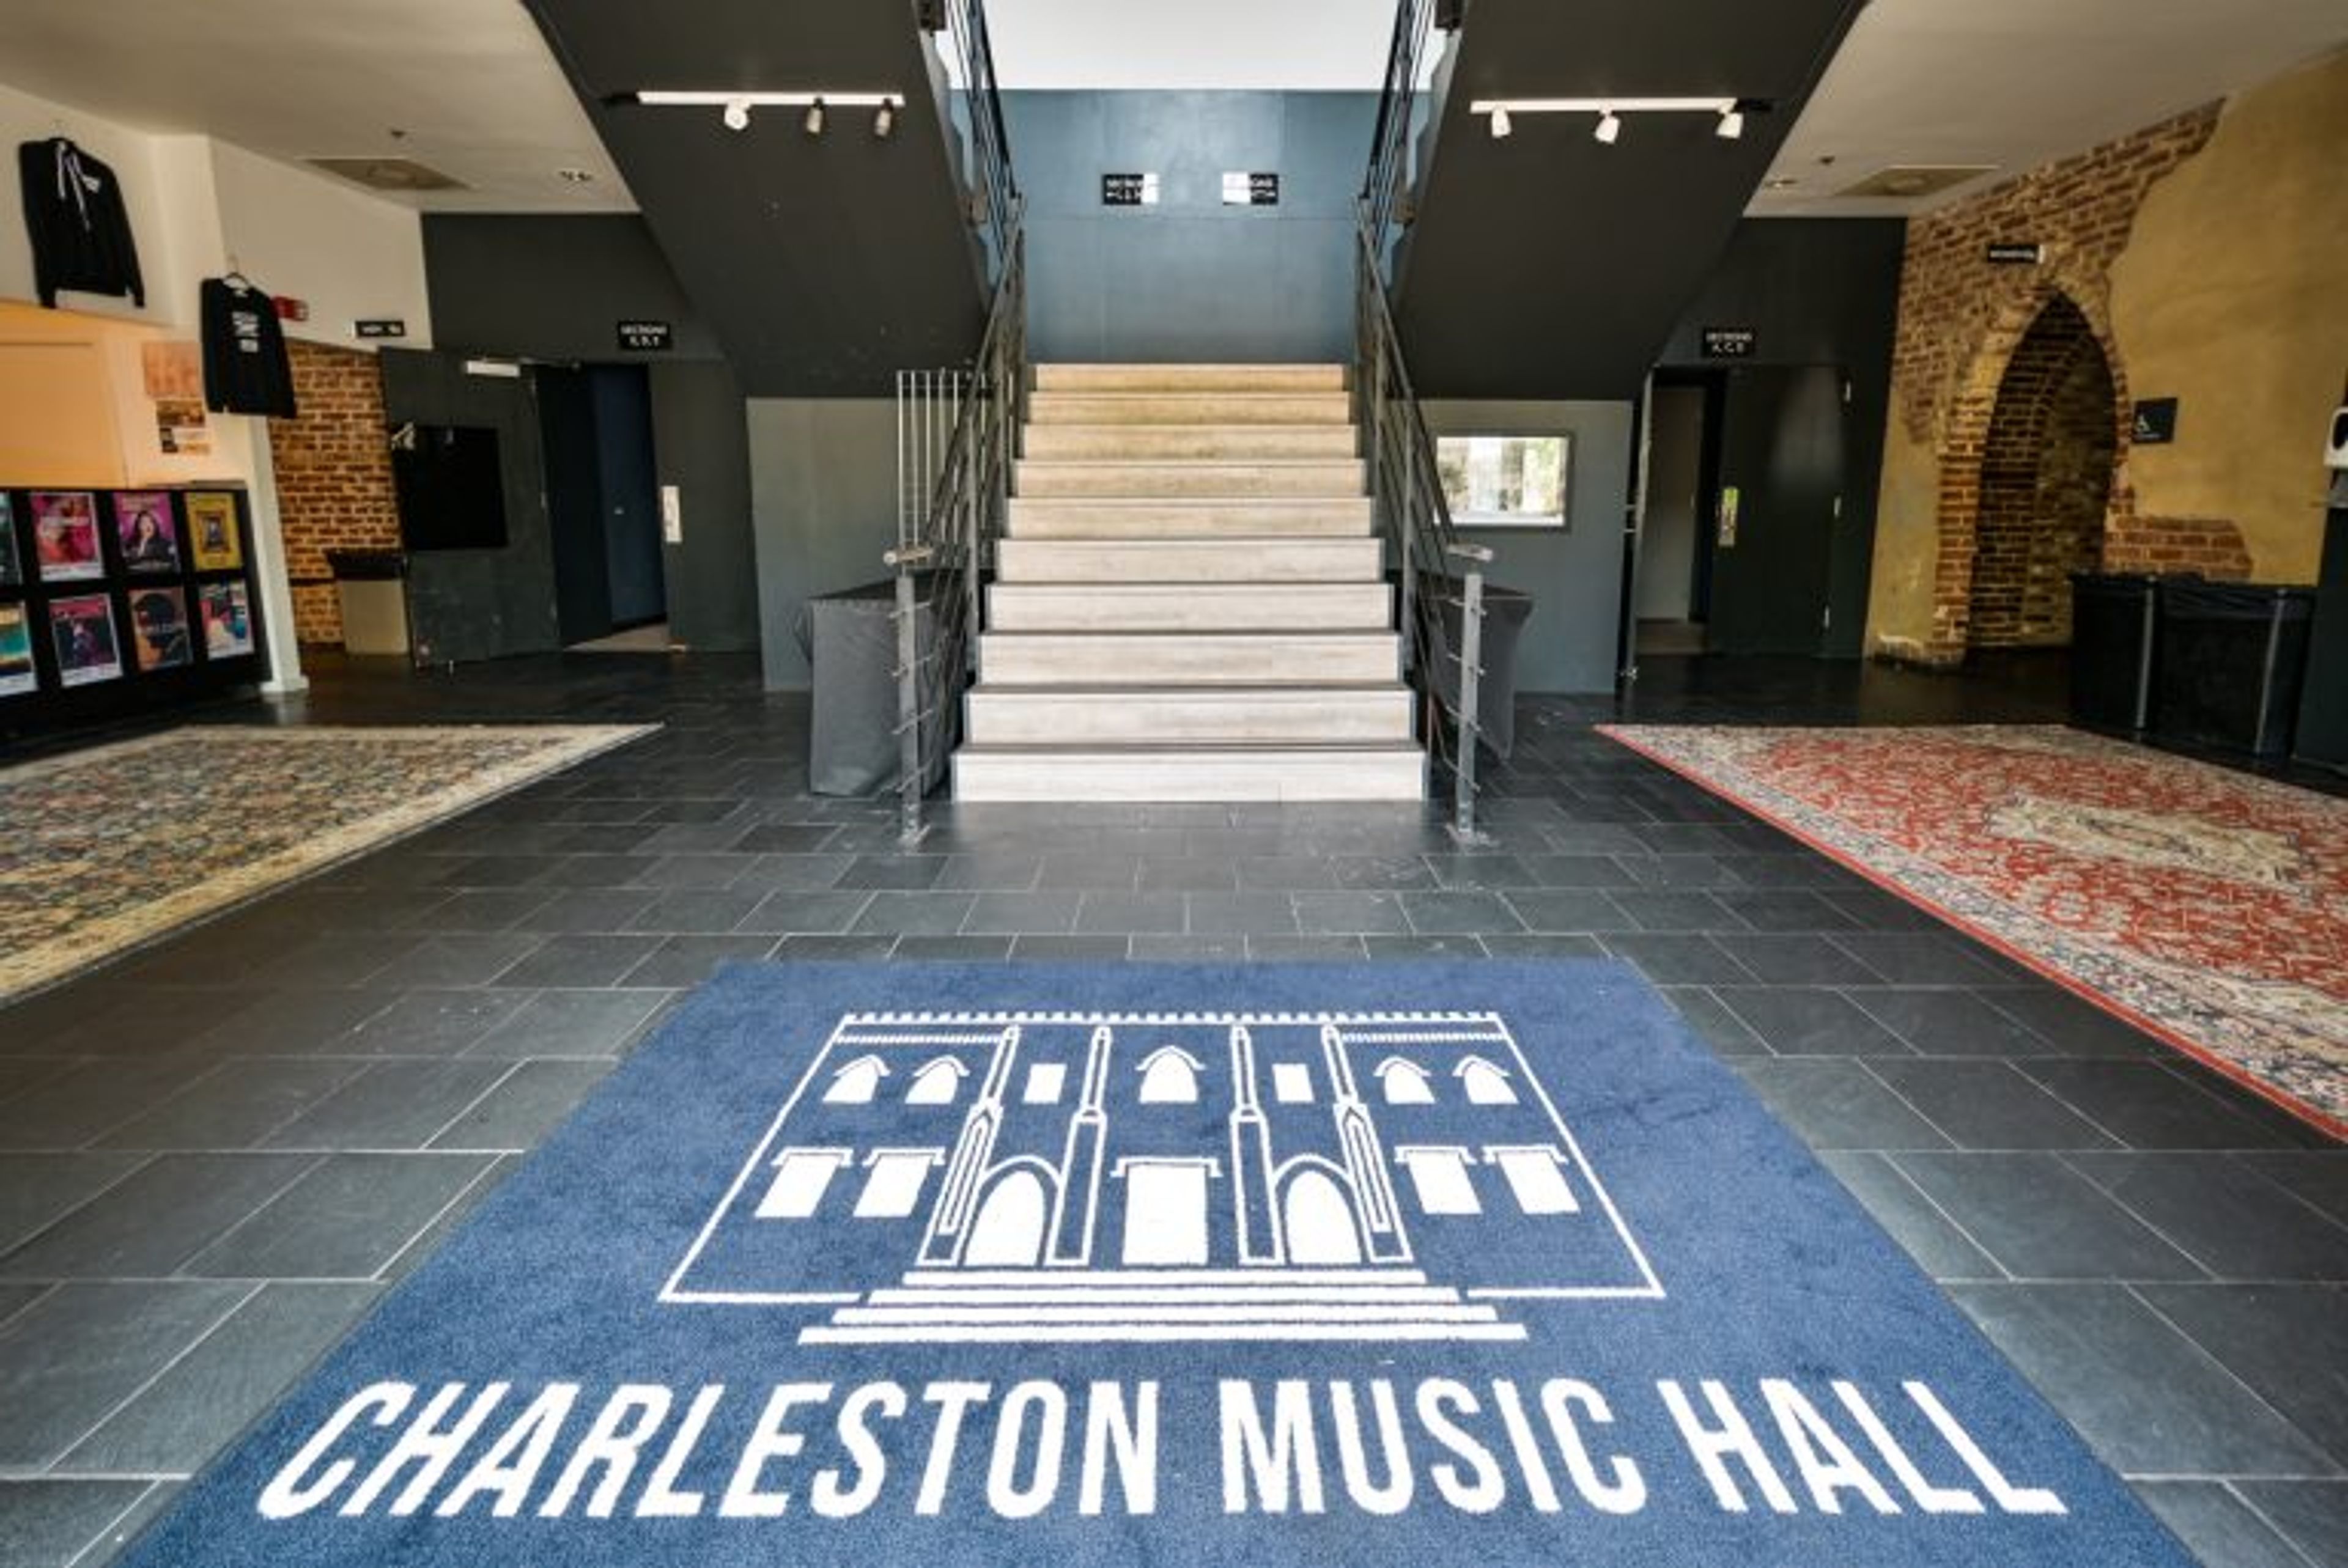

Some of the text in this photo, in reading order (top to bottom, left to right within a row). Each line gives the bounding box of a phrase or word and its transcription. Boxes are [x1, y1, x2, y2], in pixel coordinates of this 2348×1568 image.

[258, 1378, 2067, 1519] CHARLESTON MUSIC HALL
